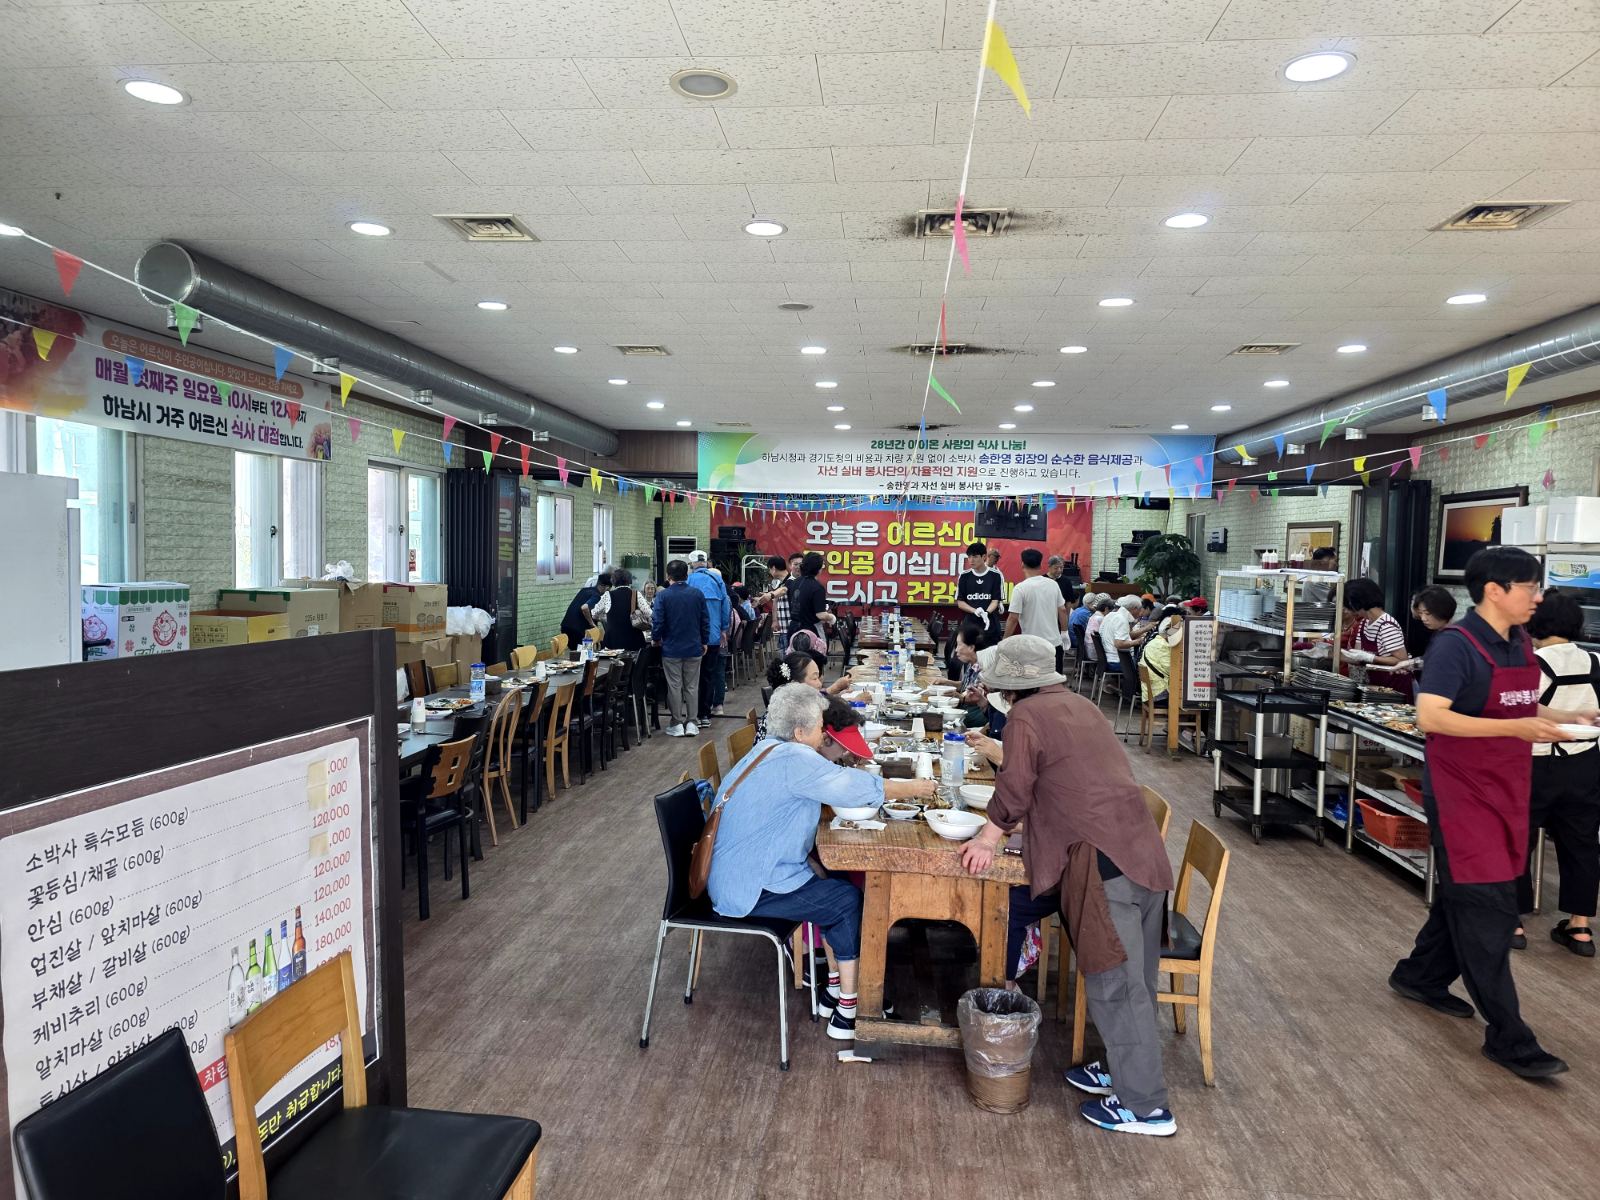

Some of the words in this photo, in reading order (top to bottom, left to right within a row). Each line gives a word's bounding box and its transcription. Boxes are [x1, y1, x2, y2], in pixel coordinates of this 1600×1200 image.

[111, 335, 138, 354] 오늘은
[140, 343, 172, 361] 어르신이
[96, 357, 129, 385] 매월
[183, 378, 223, 406] 일요일
[103, 394, 151, 423] 하남시
[156, 403, 185, 429] 거주
[189, 410, 229, 437] 어르신
[231, 417, 256, 441] 식사
[258, 424, 304, 449] 대접합니다.
[871, 439, 906, 451] 28년간
[942, 439, 974, 451] 사랑의
[978, 439, 998, 451] 식사
[1001, 439, 1027, 451] 나눔!
[817, 465, 839, 478] 자선
[841, 465, 863, 478] 실버
[865, 465, 907, 478] 봉사단의
[911, 465, 953, 478] 자율적인
[956, 465, 996, 478] 지원으로
[999, 466, 1037, 479] 진행하고
[1040, 466, 1081, 480] 있습니다.
[855, 453, 883, 464] 비용과
[927, 453, 946, 464] 없이
[948, 454, 976, 464] 소박사
[979, 453, 1012, 465] 송한영
[1014, 453, 1048, 466] 회장의
[1051, 453, 1085, 466] 순수한
[1087, 453, 1143, 466] 음식제공과
[921, 482, 939, 491] 자선
[940, 482, 956, 491] 실버
[958, 481, 983, 491] 봉사단
[985, 481, 1002, 491] 일동
[806, 521, 879, 546] 오늘은
[826, 580, 898, 605] 드시고
[966, 592, 992, 601] adidas
[26, 838, 77, 873] 소박사
[84, 817, 145, 852] 특수모듬
[149, 807, 189, 831] (600g)
[123, 845, 165, 872] (600g)
[28, 910, 62, 943] 안심
[70, 895, 114, 926] (600g)
[312, 803, 350, 829] 120,000
[31, 971, 82, 1011] 부채살
[103, 941, 148, 979] 갈비살
[152, 925, 190, 954] (600g)
[313, 850, 351, 879] 120,000
[31, 938, 82, 977] 업진살
[101, 905, 160, 946] 앞치마살
[166, 890, 203, 917] (600g)
[106, 976, 148, 1008] (600g)
[314, 874, 351, 903] 120,000
[315, 921, 352, 952] 180,000
[36, 1028, 104, 1080] 알치마살
[109, 1006, 151, 1040] (600g)
[314, 897, 352, 928] 140,000
[1117, 1108, 1138, 1123] N
